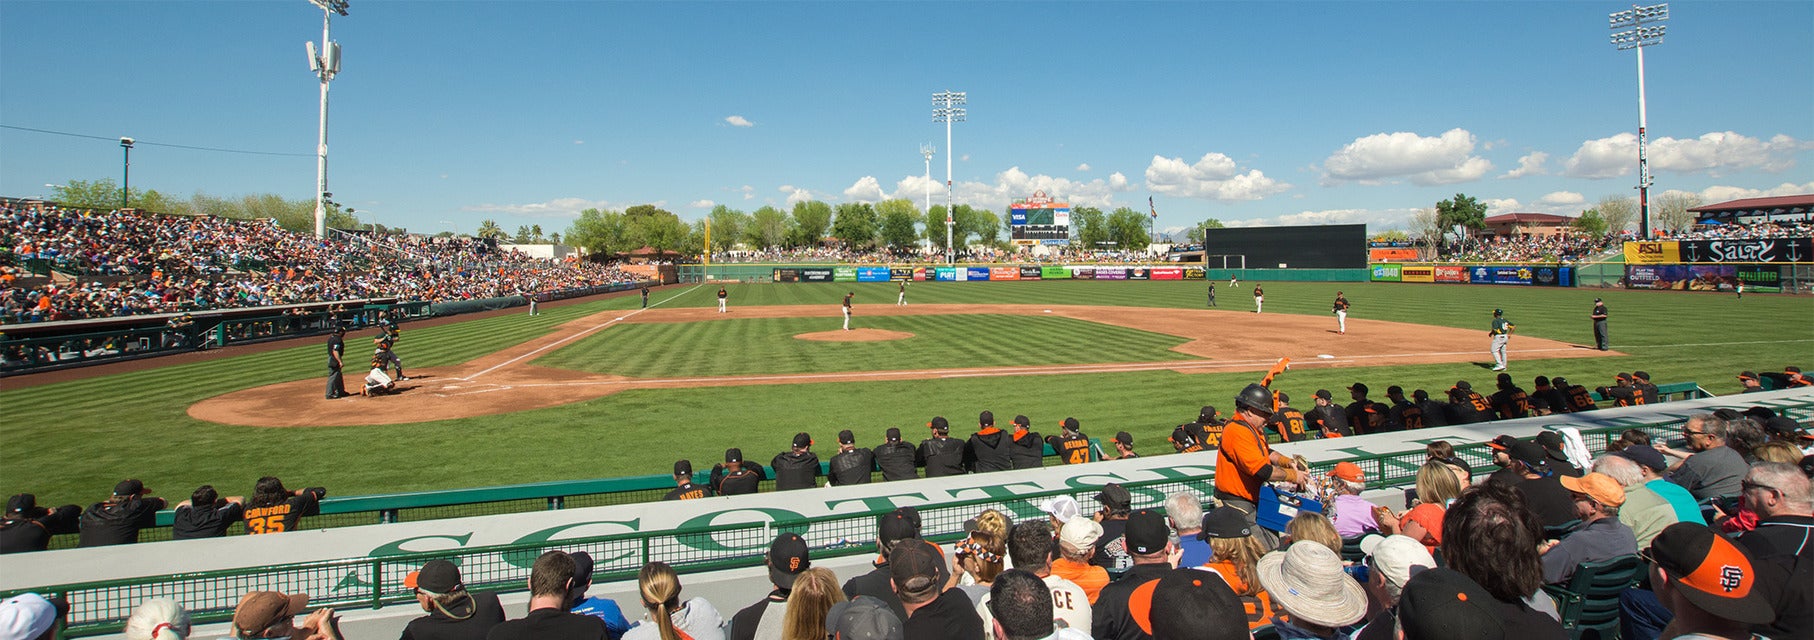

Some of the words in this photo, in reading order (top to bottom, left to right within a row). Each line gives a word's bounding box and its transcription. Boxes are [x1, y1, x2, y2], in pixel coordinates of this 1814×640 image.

[1639, 244, 1663, 254] ASU
[1069, 447, 1089, 464] 47
[245, 503, 291, 519] CRAWFORD
[249, 515, 285, 535] 35
